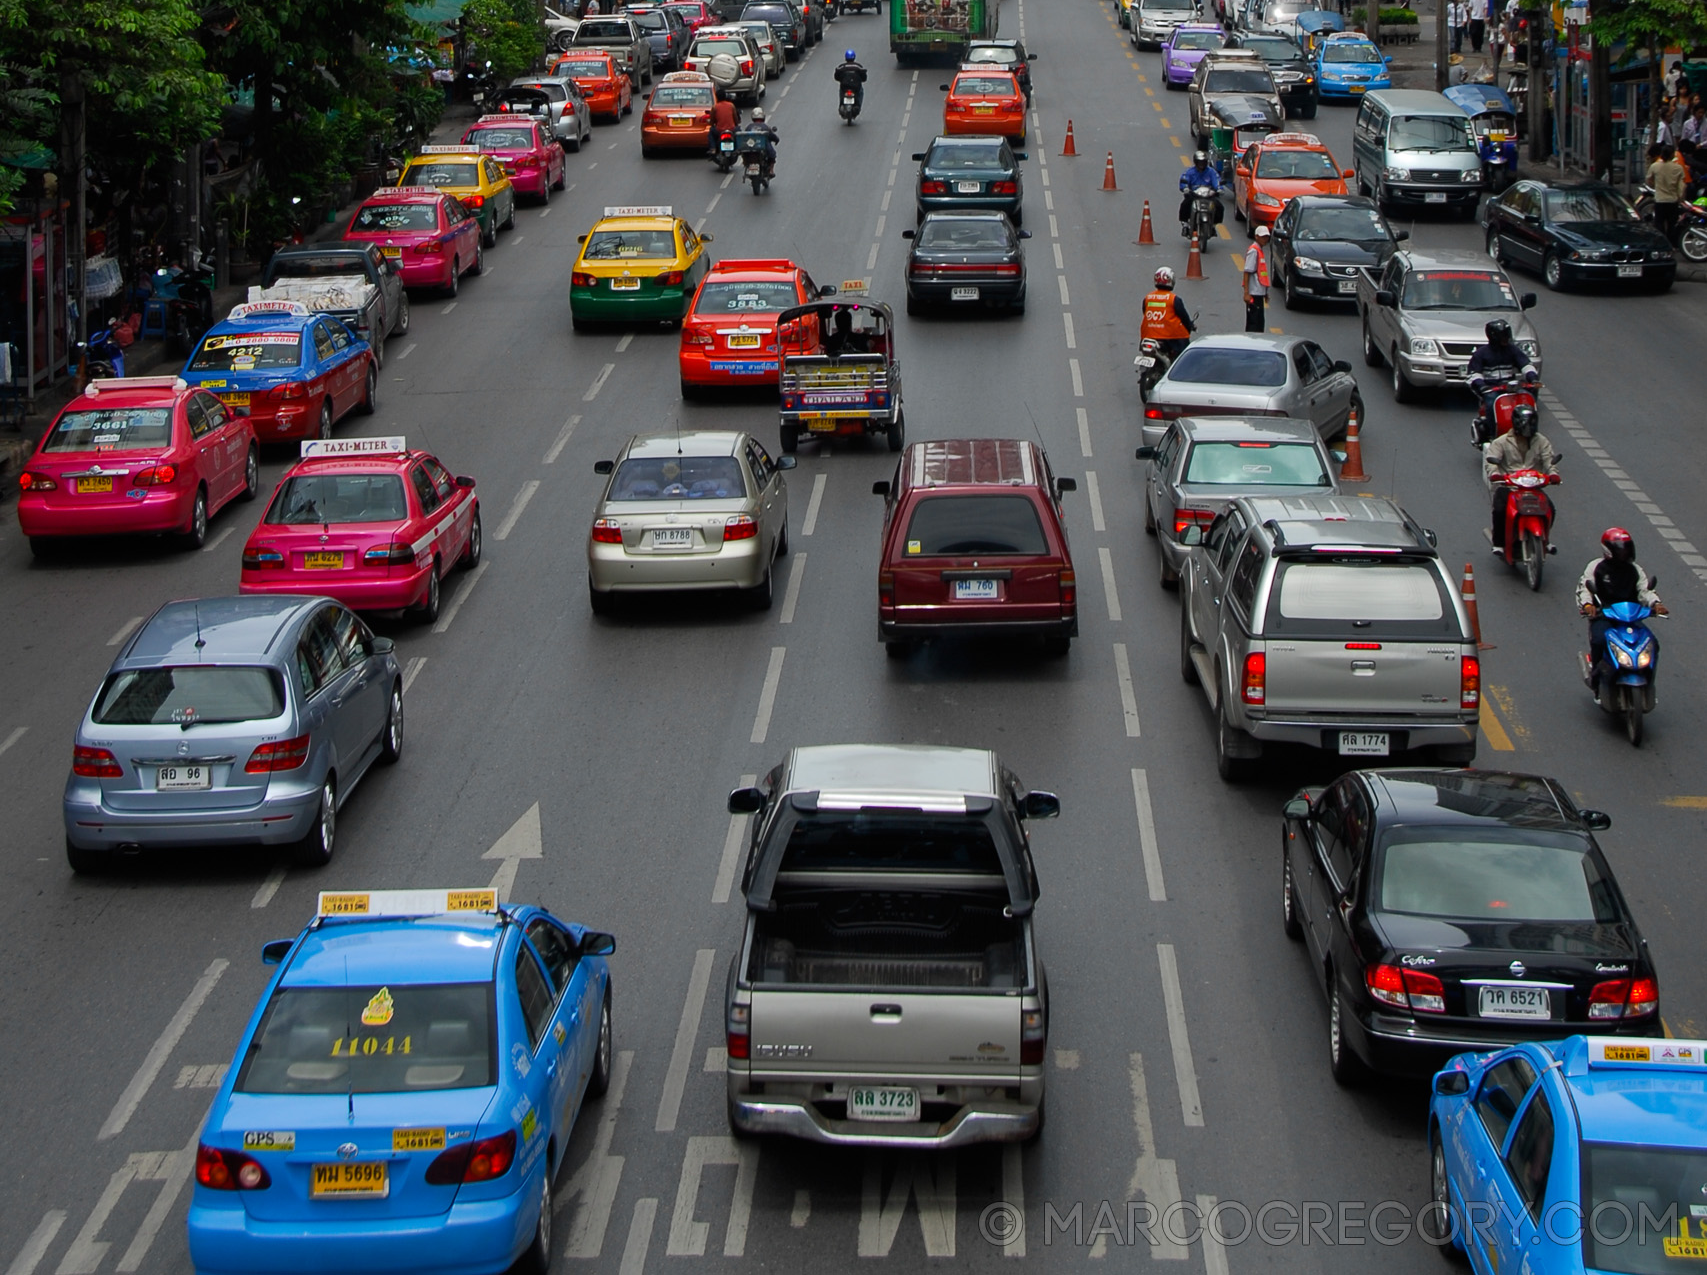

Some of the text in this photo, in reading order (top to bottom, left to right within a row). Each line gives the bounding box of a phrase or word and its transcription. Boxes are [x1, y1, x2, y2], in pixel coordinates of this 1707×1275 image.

[844, 281, 863, 289] TAXI
[727, 299, 767, 308] 3883
[227, 346, 263, 356] 4212
[92, 420, 129, 430] 3661
[669, 530, 691, 540] 8788
[976, 581, 994, 591] 760
[1361, 734, 1387, 747] 1774
[160, 767, 201, 780] สอ 96
[332, 903, 355, 912] 1681
[458, 900, 481, 909] 1681
[1510, 990, 1544, 1007] 6521
[330, 1035, 412, 1057] 11044
[1613, 1051, 1637, 1060] 1681
[879, 1090, 915, 1108] 3723
[244, 1131, 275, 1146] GPS
[404, 1137, 430, 1147] 1681
[343, 1165, 383, 1182] 5696
[1678, 1245, 1706, 1256] 1681
